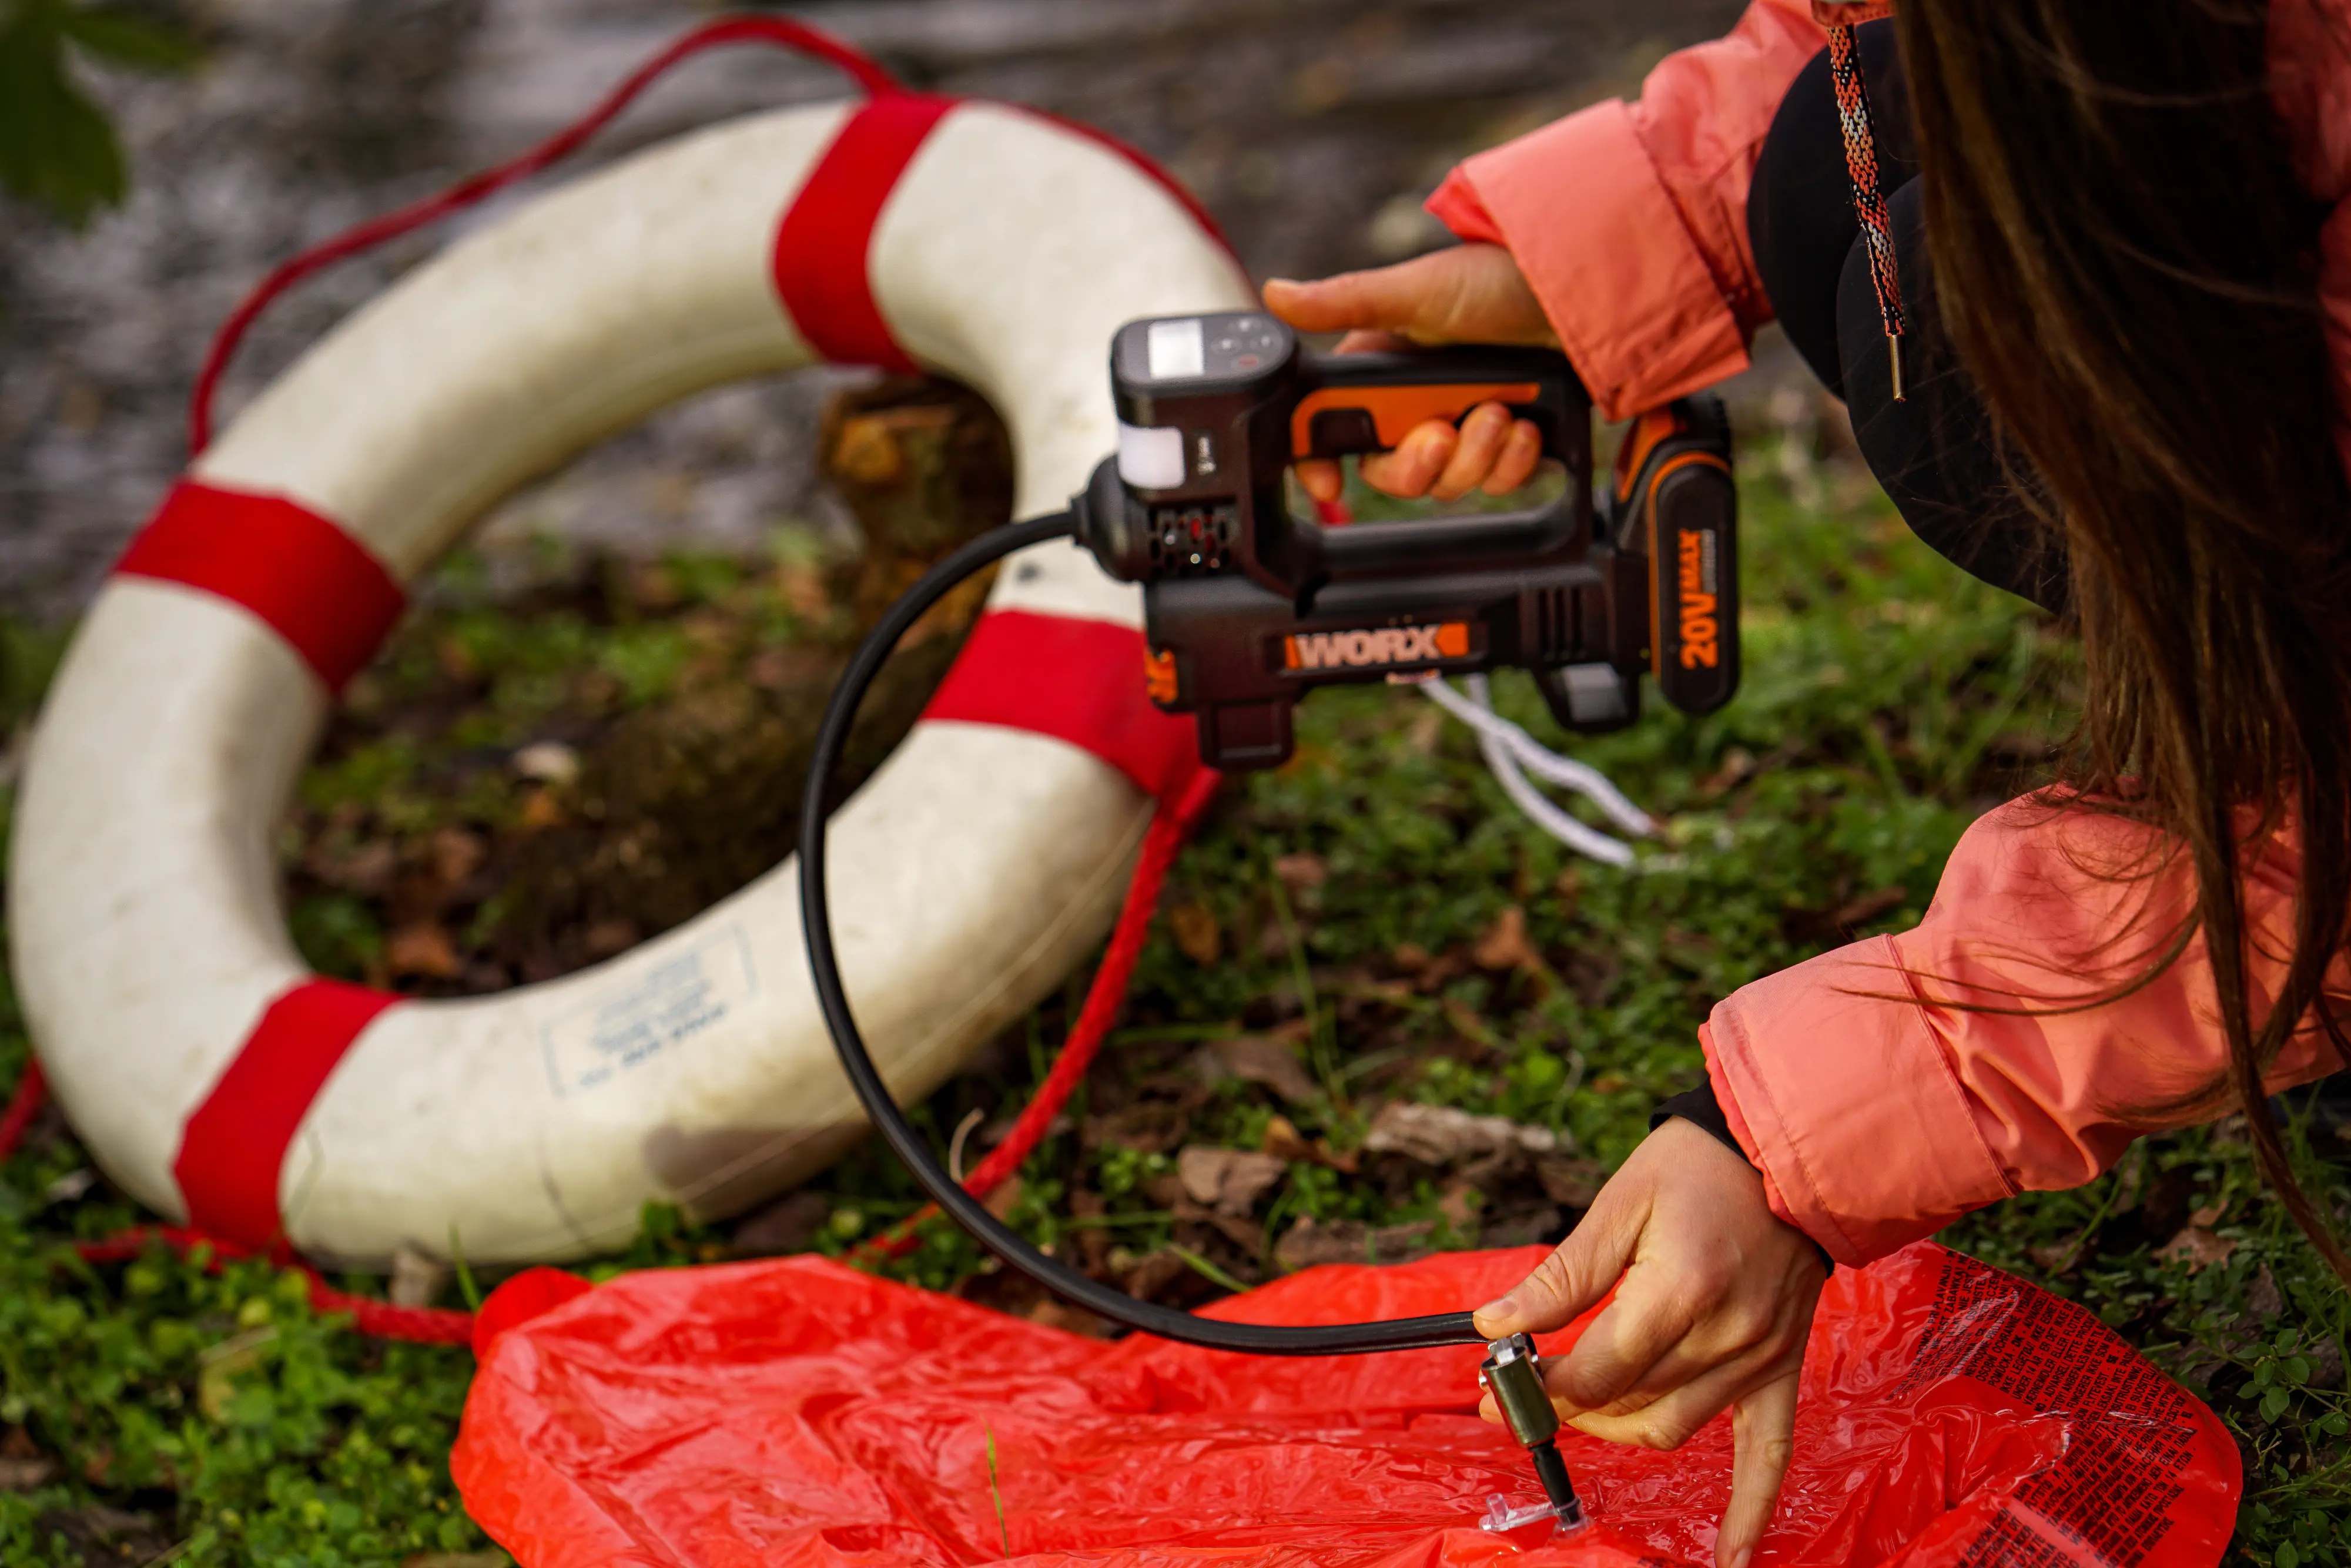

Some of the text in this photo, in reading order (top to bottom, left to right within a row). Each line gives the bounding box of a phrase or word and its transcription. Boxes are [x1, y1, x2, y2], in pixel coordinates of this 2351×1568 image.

[1294, 624, 1441, 669] WORX
[1962, 1272, 1975, 1294] JEST
[1967, 1260, 1980, 1270] TO
[1933, 1265, 1951, 1309] PLAVANJU
[1957, 1296, 1969, 1310] NIE
[1965, 1278, 1987, 1320] OSOBISTEJ
[1927, 1310, 1940, 1324] PRI
[1930, 1337, 1942, 1349] NIE
[1937, 1315, 1950, 1334] JEST
[1950, 1317, 1961, 1329] LAT
[1985, 1325, 2001, 1339] PRO
[2011, 1334, 2024, 1347] DK
[2022, 1297, 2048, 1328] ADVARSEL!
[1999, 1375, 2016, 1393] IKKE
[2030, 1324, 2045, 1342] IKKE
[2039, 1301, 2057, 1324] EGNET
[2011, 1375, 2031, 1399] UNDER
[2025, 1365, 2037, 1375] 14
[2038, 1341, 2051, 1352] ER
[2045, 1326, 2059, 1342] DET
[2053, 1310, 2069, 1327] IKKE
[2062, 1355, 2089, 1392] ANBEFALES
[2082, 1338, 2098, 1355] IKKE
[2023, 1358, 2056, 1405] VÆRNEMIDLER
[2050, 1337, 2069, 1358] ELLER
[2033, 1402, 2047, 1412] NO
[2044, 1362, 2069, 1397] ADVARSEL!
[2063, 1339, 2082, 1362] DETTE
[2066, 1375, 2092, 1408] FUNGERER
[2085, 1358, 2102, 1374] IKKE
[2095, 1342, 2109, 1357] SOM
[2096, 1383, 2117, 1410] LEKSAK!
[2110, 1368, 2126, 1383] INTE
[2073, 1407, 2088, 1422] SOM
[2082, 1372, 2108, 1406] FLYTEVEST
[2125, 1403, 2136, 1411] EI
[2133, 1440, 2165, 1475] СПАСЕНИЯ
[2160, 1432, 2173, 1442] НА
[2165, 1470, 2176, 1481] 14
[2031, 1532, 2047, 1547] TE
